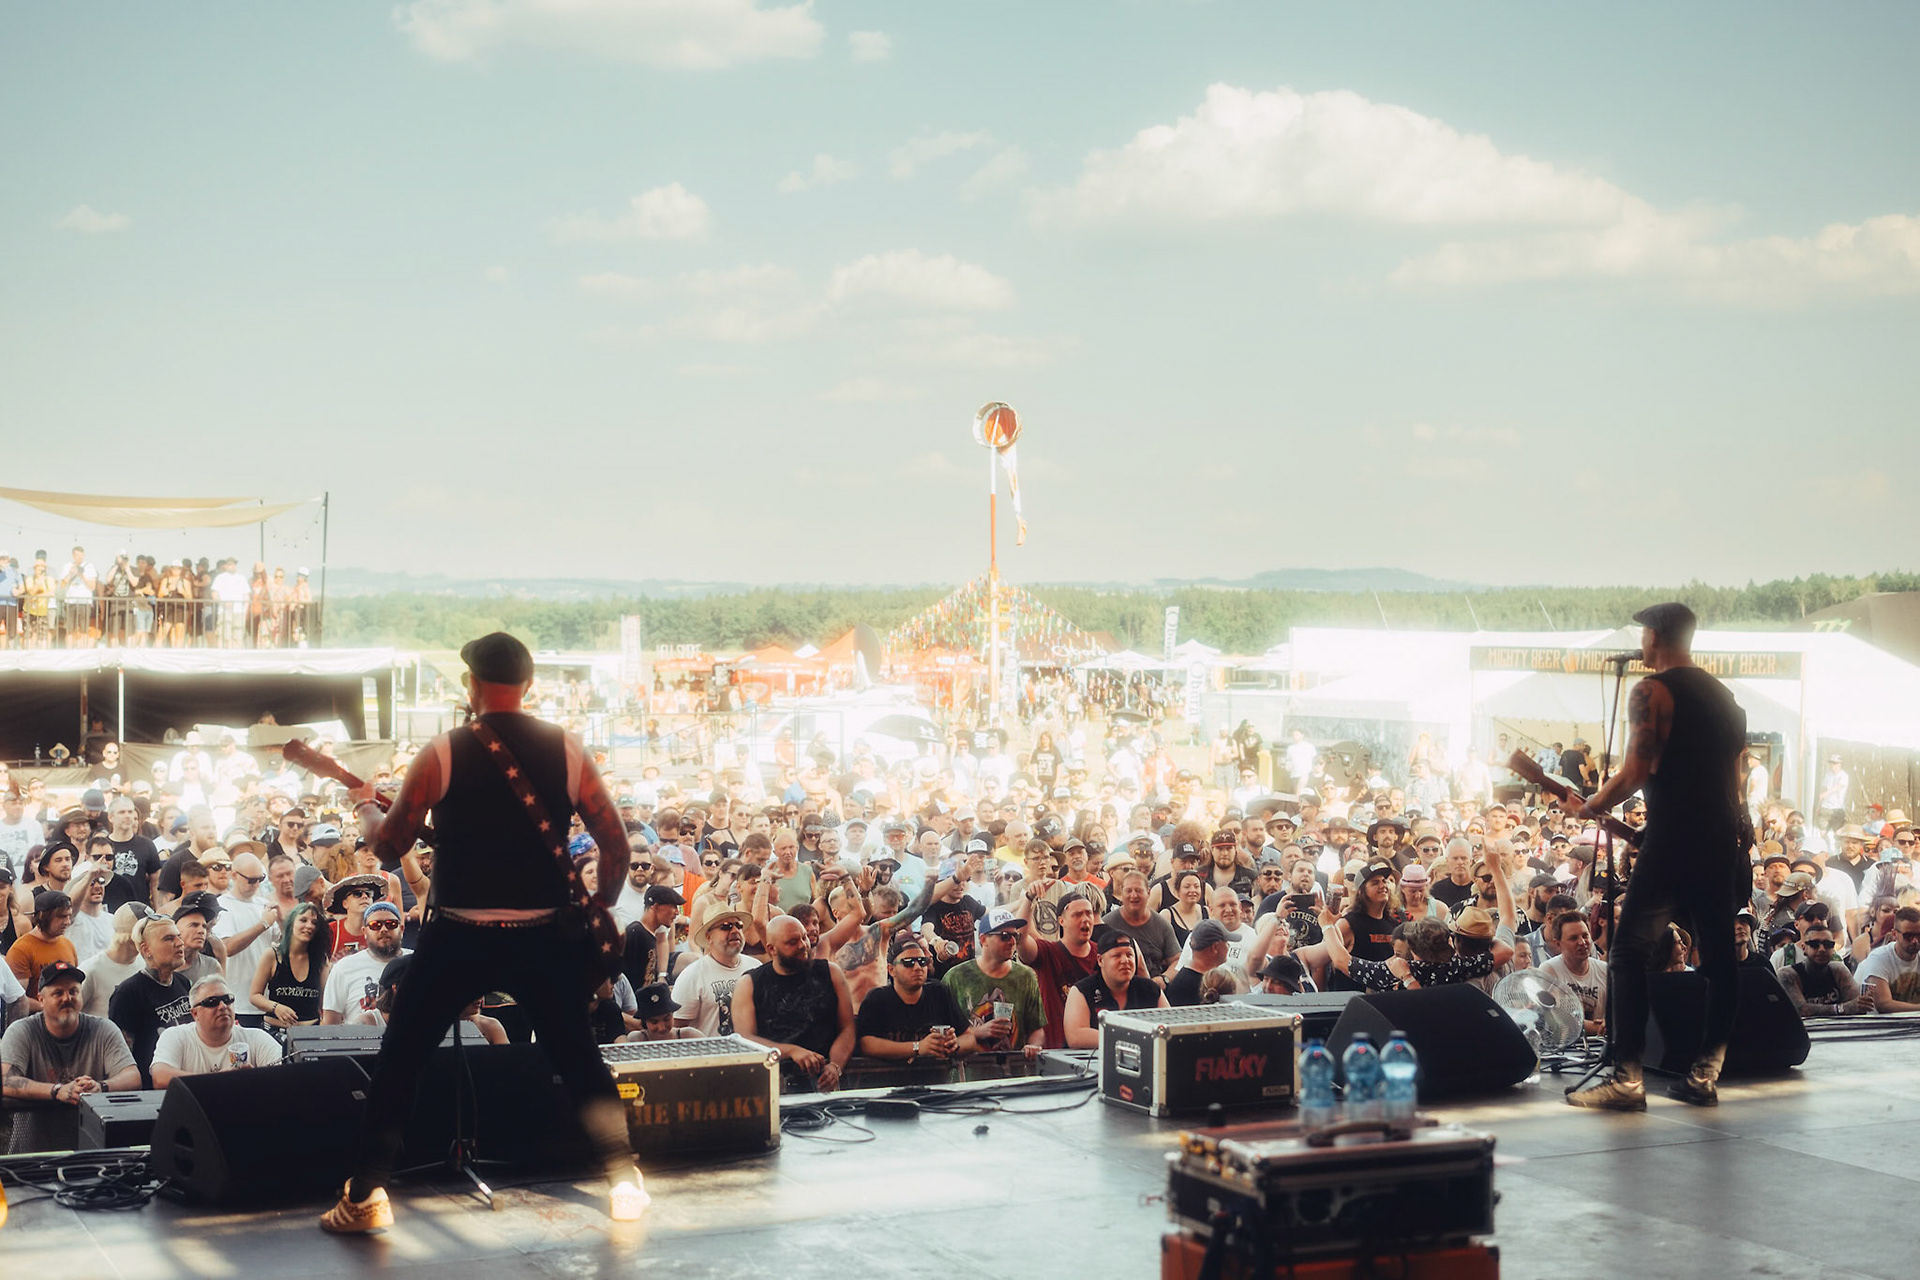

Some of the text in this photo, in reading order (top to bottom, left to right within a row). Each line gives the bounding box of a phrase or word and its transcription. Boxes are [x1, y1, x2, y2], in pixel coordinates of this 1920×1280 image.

[1488, 648, 1528, 668] MIGHTY
[1531, 649, 1560, 669] BEER
[1739, 653, 1776, 675] BEER
[1195, 1054, 1268, 1081] FIALKY
[677, 1096, 766, 1121] FIALKY
